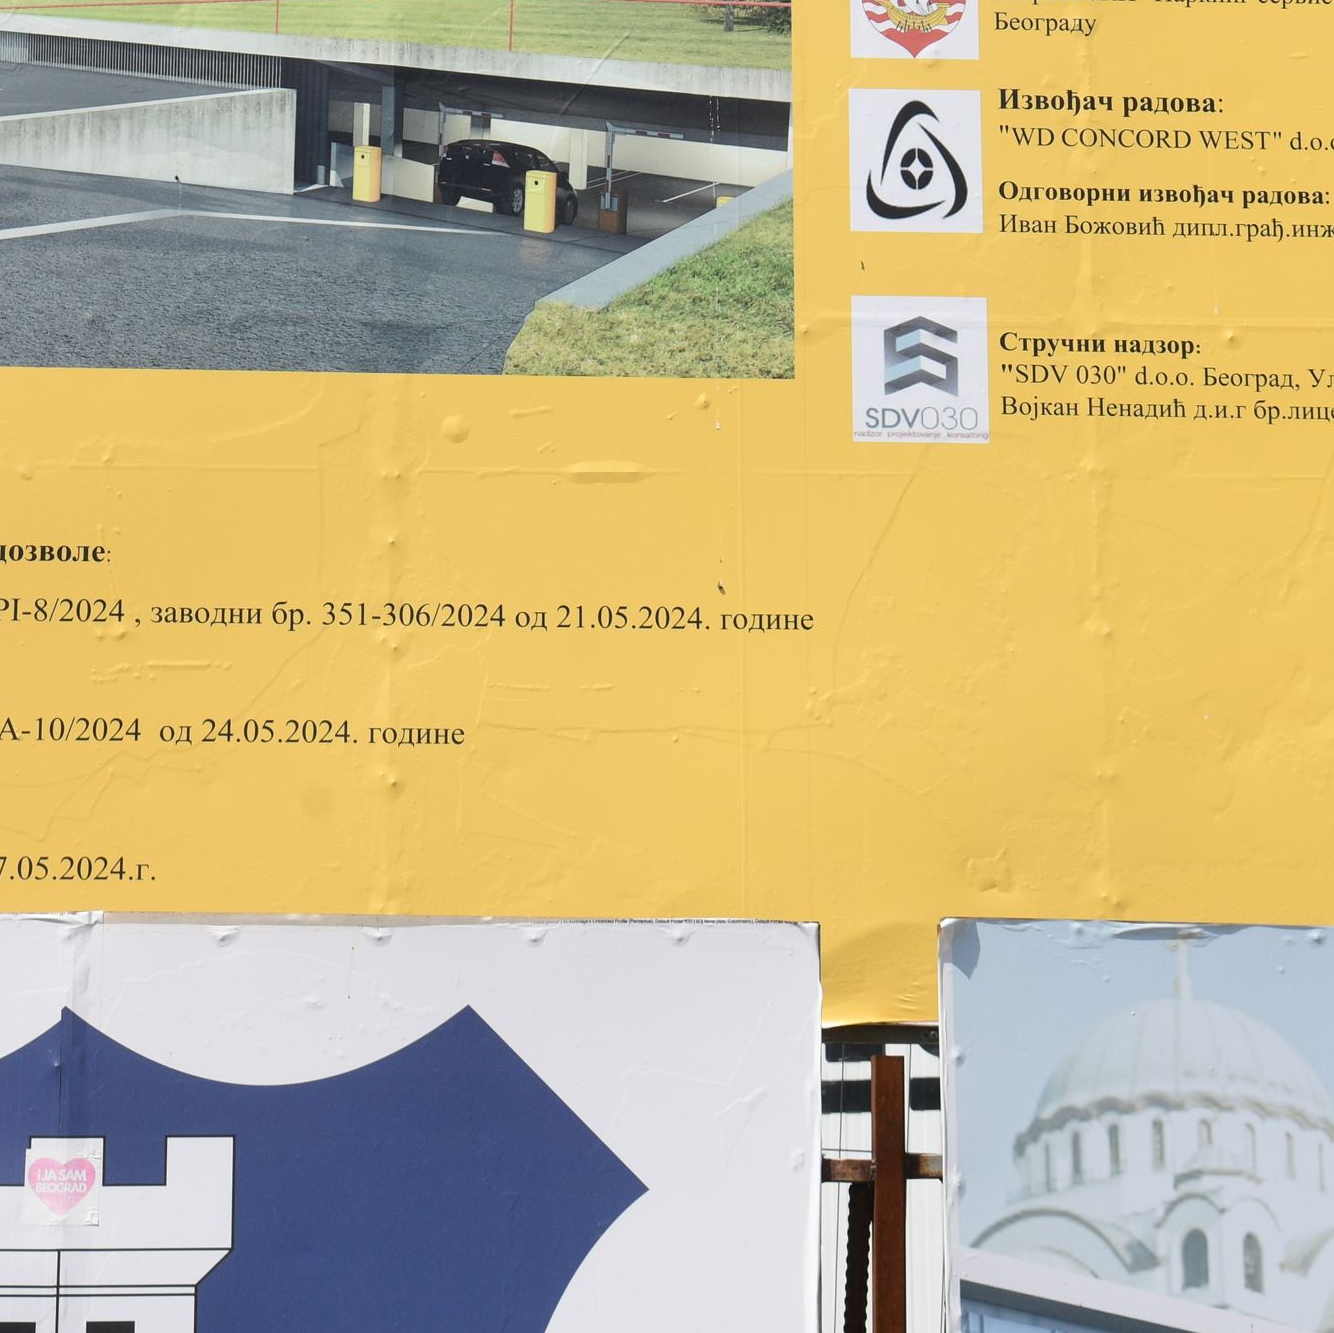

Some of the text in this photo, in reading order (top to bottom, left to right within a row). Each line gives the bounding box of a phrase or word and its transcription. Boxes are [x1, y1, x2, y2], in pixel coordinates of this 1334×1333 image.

[994, 12, 1097, 37] Београду
[997, 89, 1224, 118] Извођач радова:
[999, 125, 1055, 147] "WD
[1061, 128, 1192, 149] CONCORD
[1197, 131, 1282, 151] WEST"
[998, 181, 1330, 210] Одговорни извођач радова:
[998, 214, 1058, 234] Иван
[1063, 215, 1166, 236] Божовић
[999, 332, 1201, 360] Стручни надзор:
[1001, 364, 1069, 385] "SDV
[1075, 365, 1127, 385] 030"
[1202, 367, 1301, 393] Београд,
[865, 406, 978, 431] SDV030
[1000, 396, 1079, 422] Војкан
[1086, 397, 1187, 421] Ненадић
[150, 607, 263, 628] заводни
[271, 601, 312, 632] бр.
[321, 602, 506, 628] 351-306/2024
[514, 611, 548, 632] од
[719, 614, 815, 634] године
[159, 726, 193, 747] од
[367, 728, 465, 749] године
[35, 1182, 87, 1193] BEOGRAD
[42, 1169, 57, 1182] JA
[58, 1169, 87, 1182] SAM
